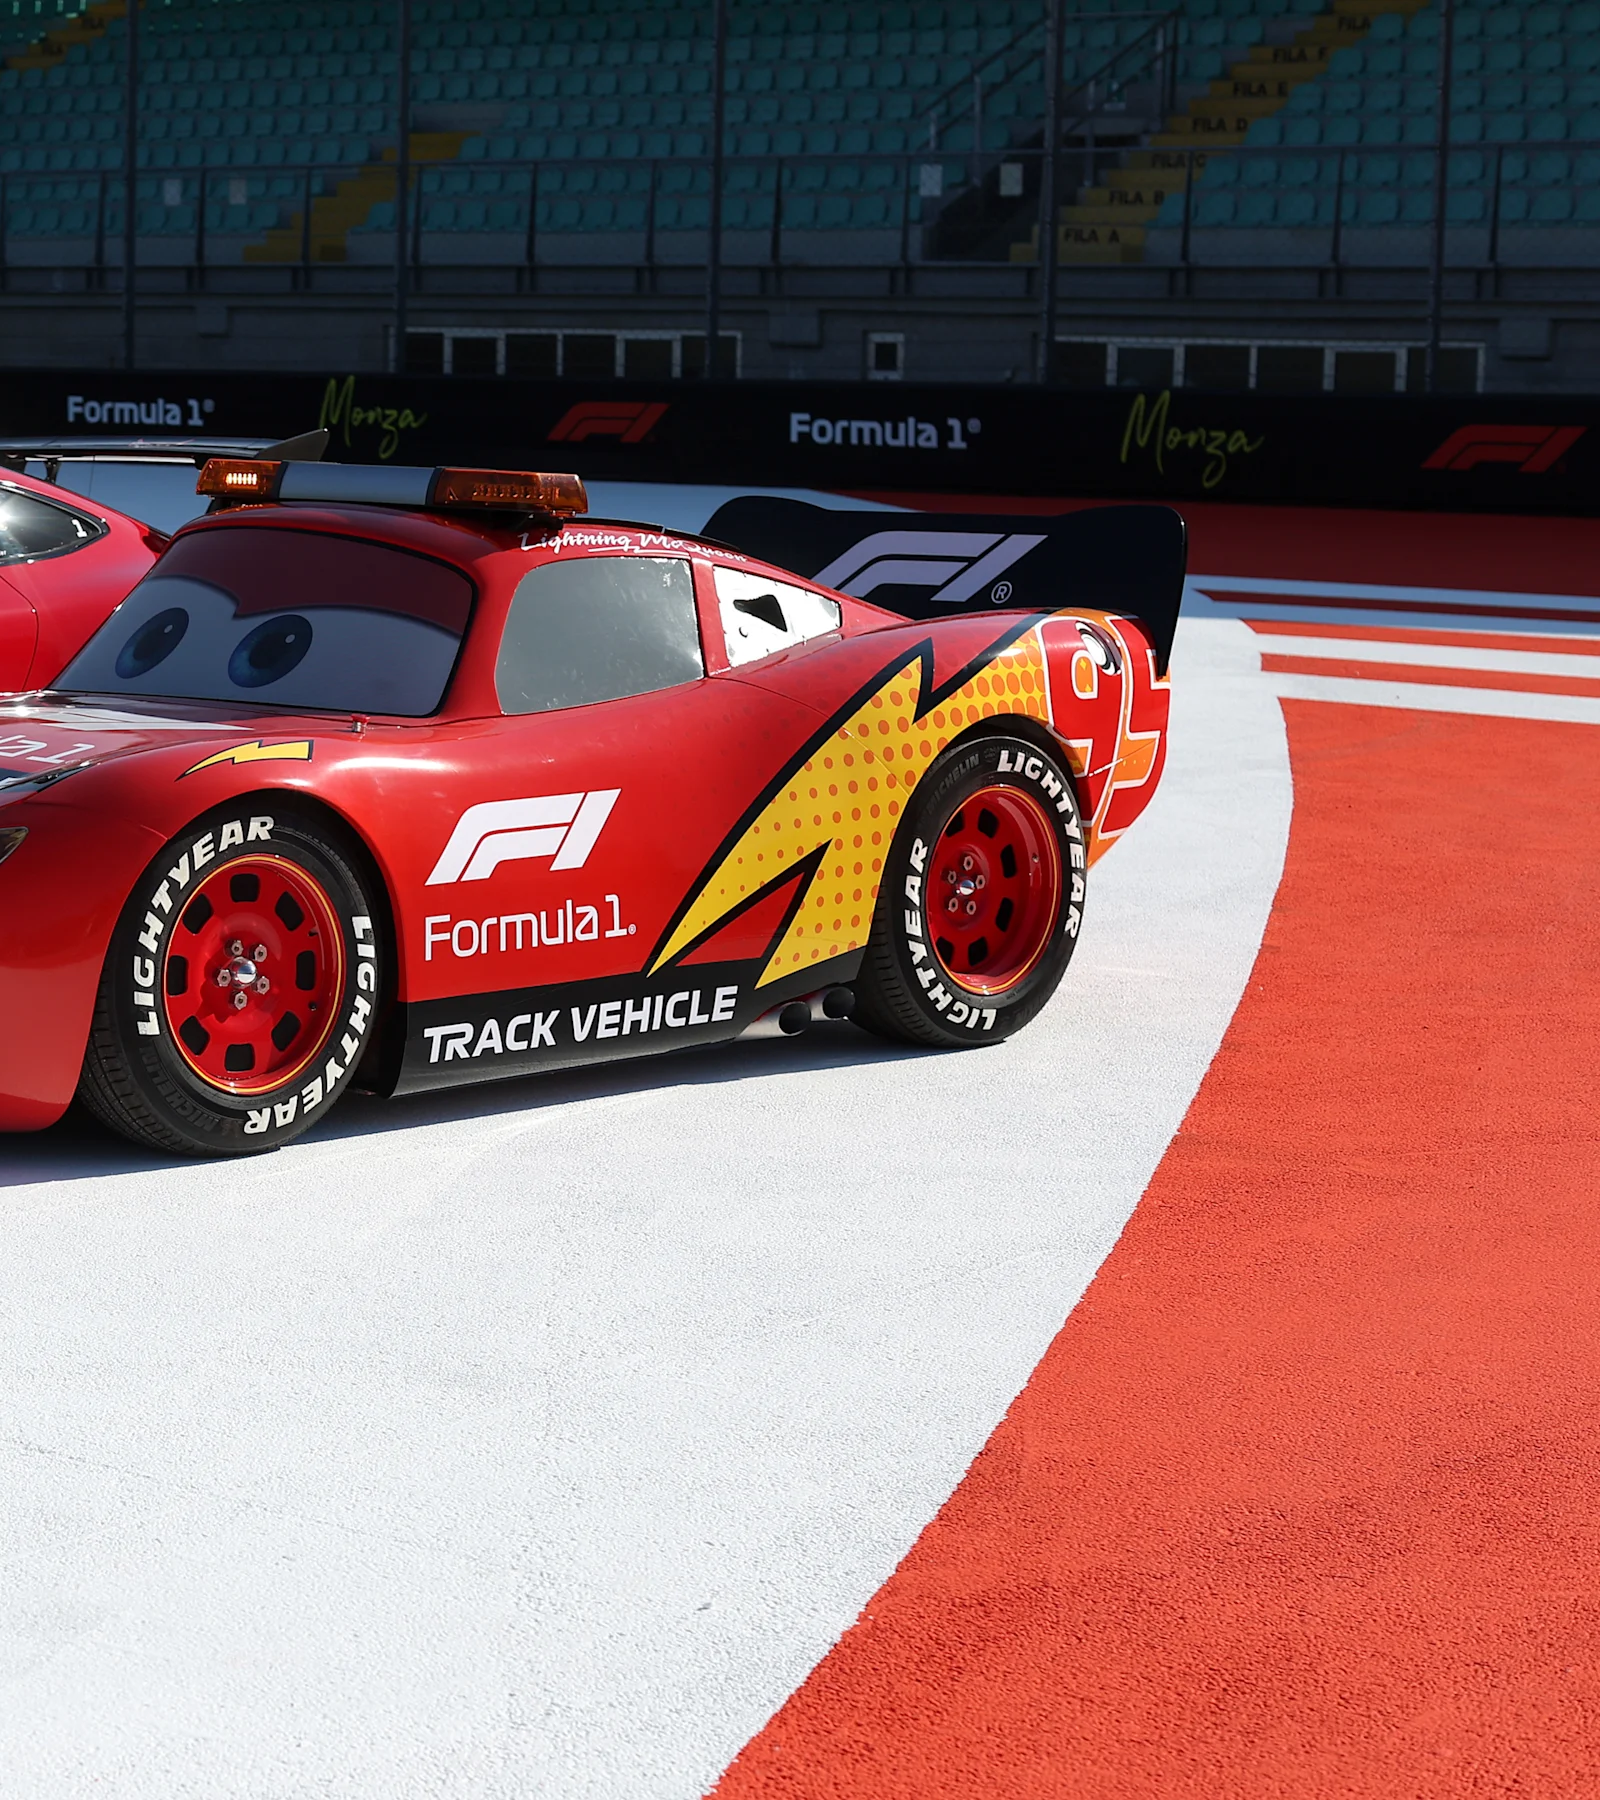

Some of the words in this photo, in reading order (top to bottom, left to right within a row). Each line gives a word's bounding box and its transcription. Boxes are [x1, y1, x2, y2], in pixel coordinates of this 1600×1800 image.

[1273, 48, 1307, 63] FILA
[1233, 82, 1267, 96] FILA
[1277, 82, 1288, 96] E
[1192, 119, 1226, 132] FILA
[1236, 118, 1248, 131] D
[1151, 154, 1187, 169] FILA
[1109, 190, 1144, 205] FILA
[1064, 229, 1099, 243] FILA
[1108, 229, 1120, 243] A
[66, 394, 183, 427] Formula
[319, 375, 428, 459] Monza
[789, 411, 939, 449] Formula
[1120, 389, 1264, 489] Monza
[518, 530, 632, 555] Lightning
[996, 749, 1086, 939] LIGHTYEAR
[133, 815, 275, 1036] LIGHTYEAR
[423, 899, 600, 962] Formula
[903, 837, 998, 1031] LIGHTYEAR
[242, 914, 376, 1135] LIGHTYEAR
[422, 1008, 561, 1064] TRACK
[569, 984, 739, 1043] VEHICLE
